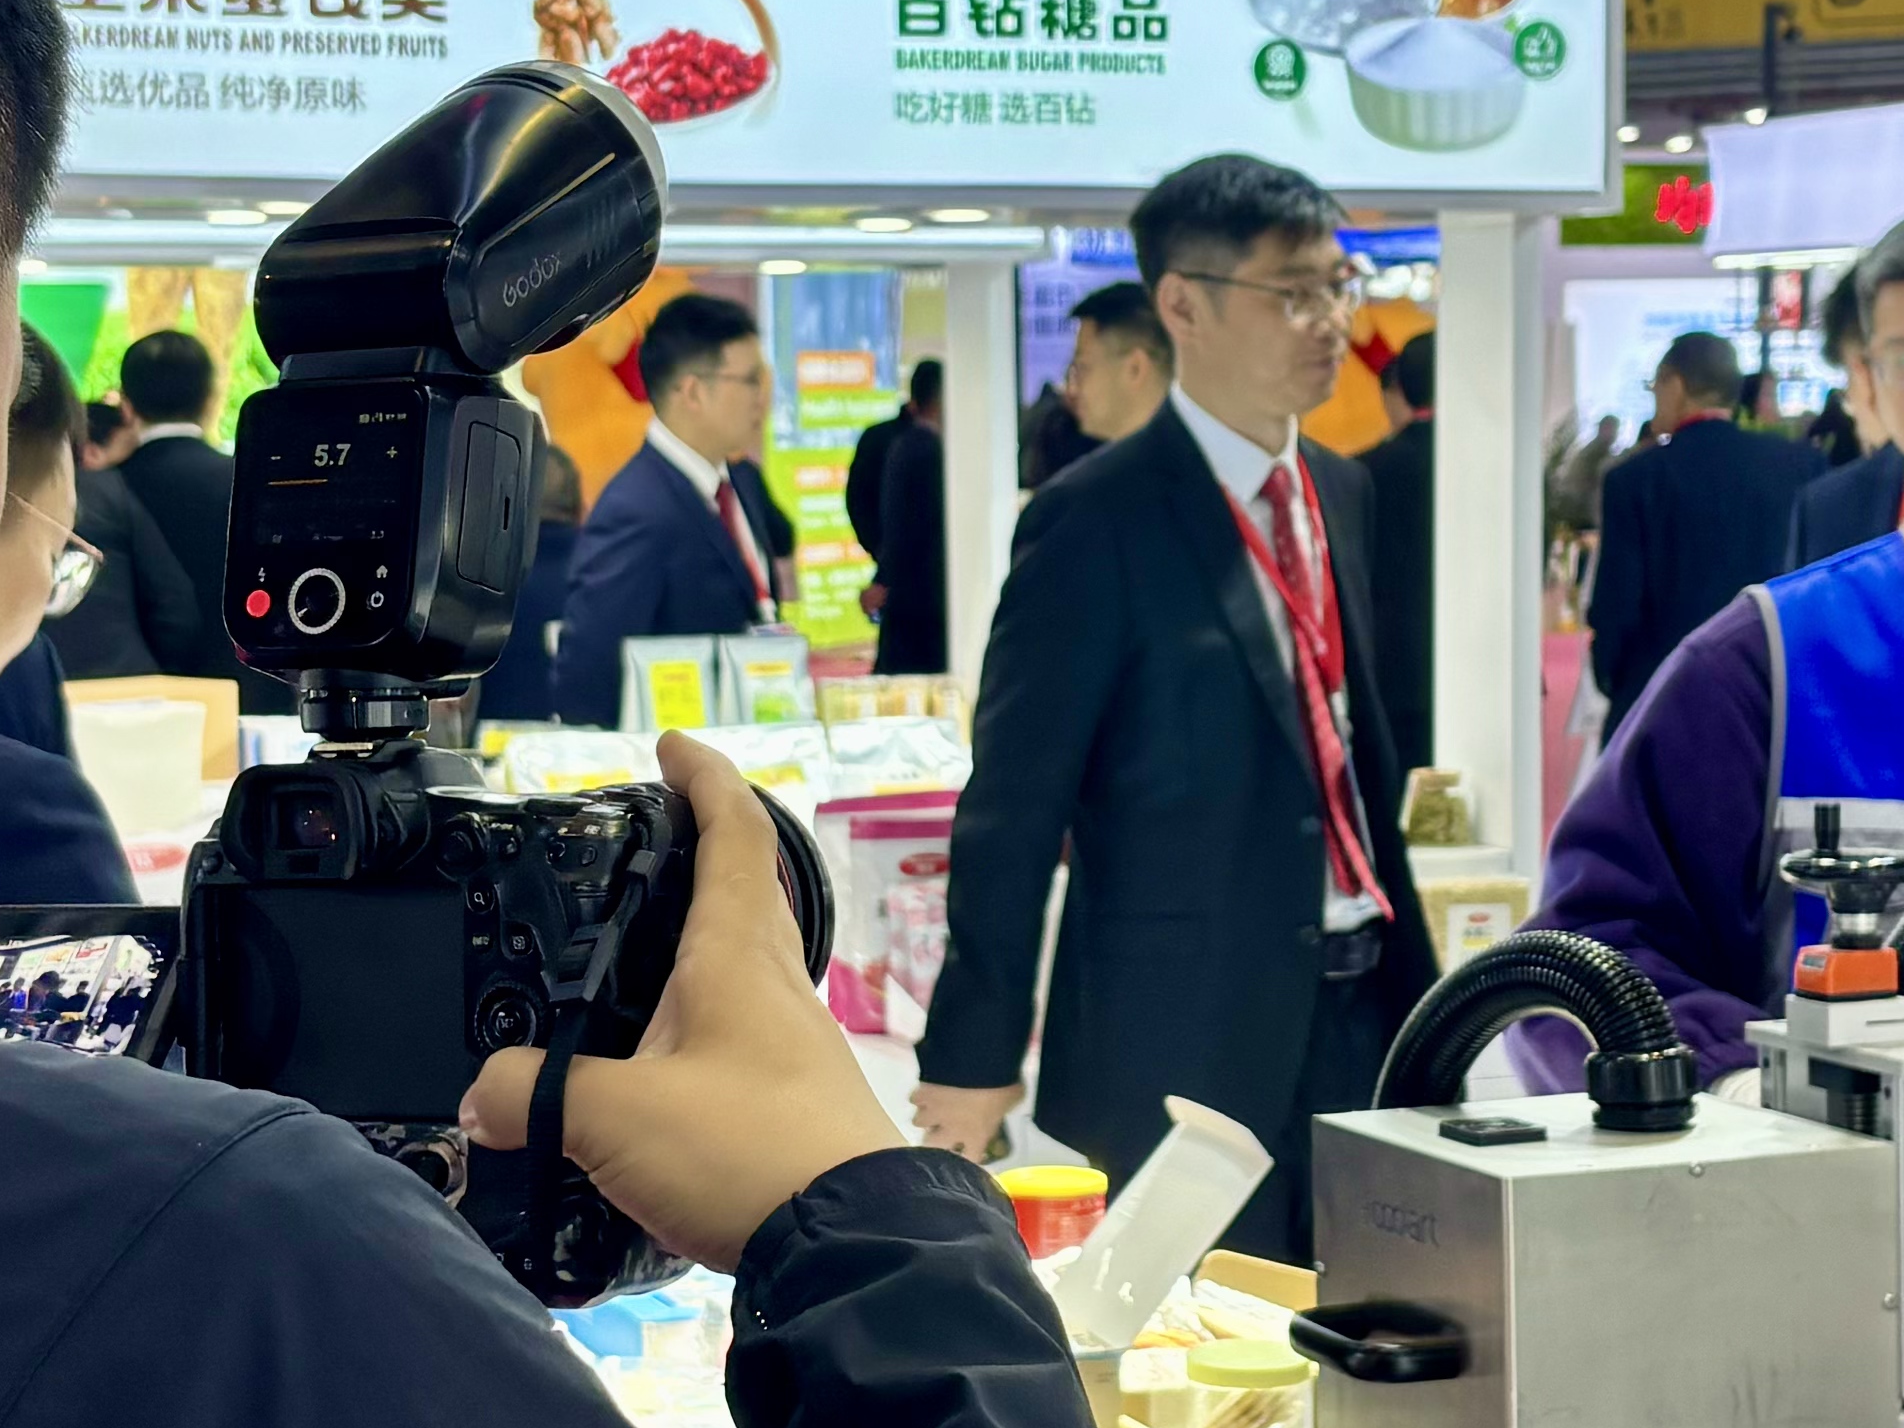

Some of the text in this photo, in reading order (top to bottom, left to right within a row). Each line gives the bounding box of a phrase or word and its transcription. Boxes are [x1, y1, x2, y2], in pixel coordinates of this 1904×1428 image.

[75, 24, 449, 60] KERDREAM NUTS AND PRESERVED FRUITS
[896, 47, 1011, 71] BAKERDREAM
[1078, 52, 1167, 75] PRODUCTS
[80, 70, 366, 113] 选优品 纯净原味
[895, 88, 1096, 125] 吃好糖 选百钻
[314, 443, 352, 467] 5.7
